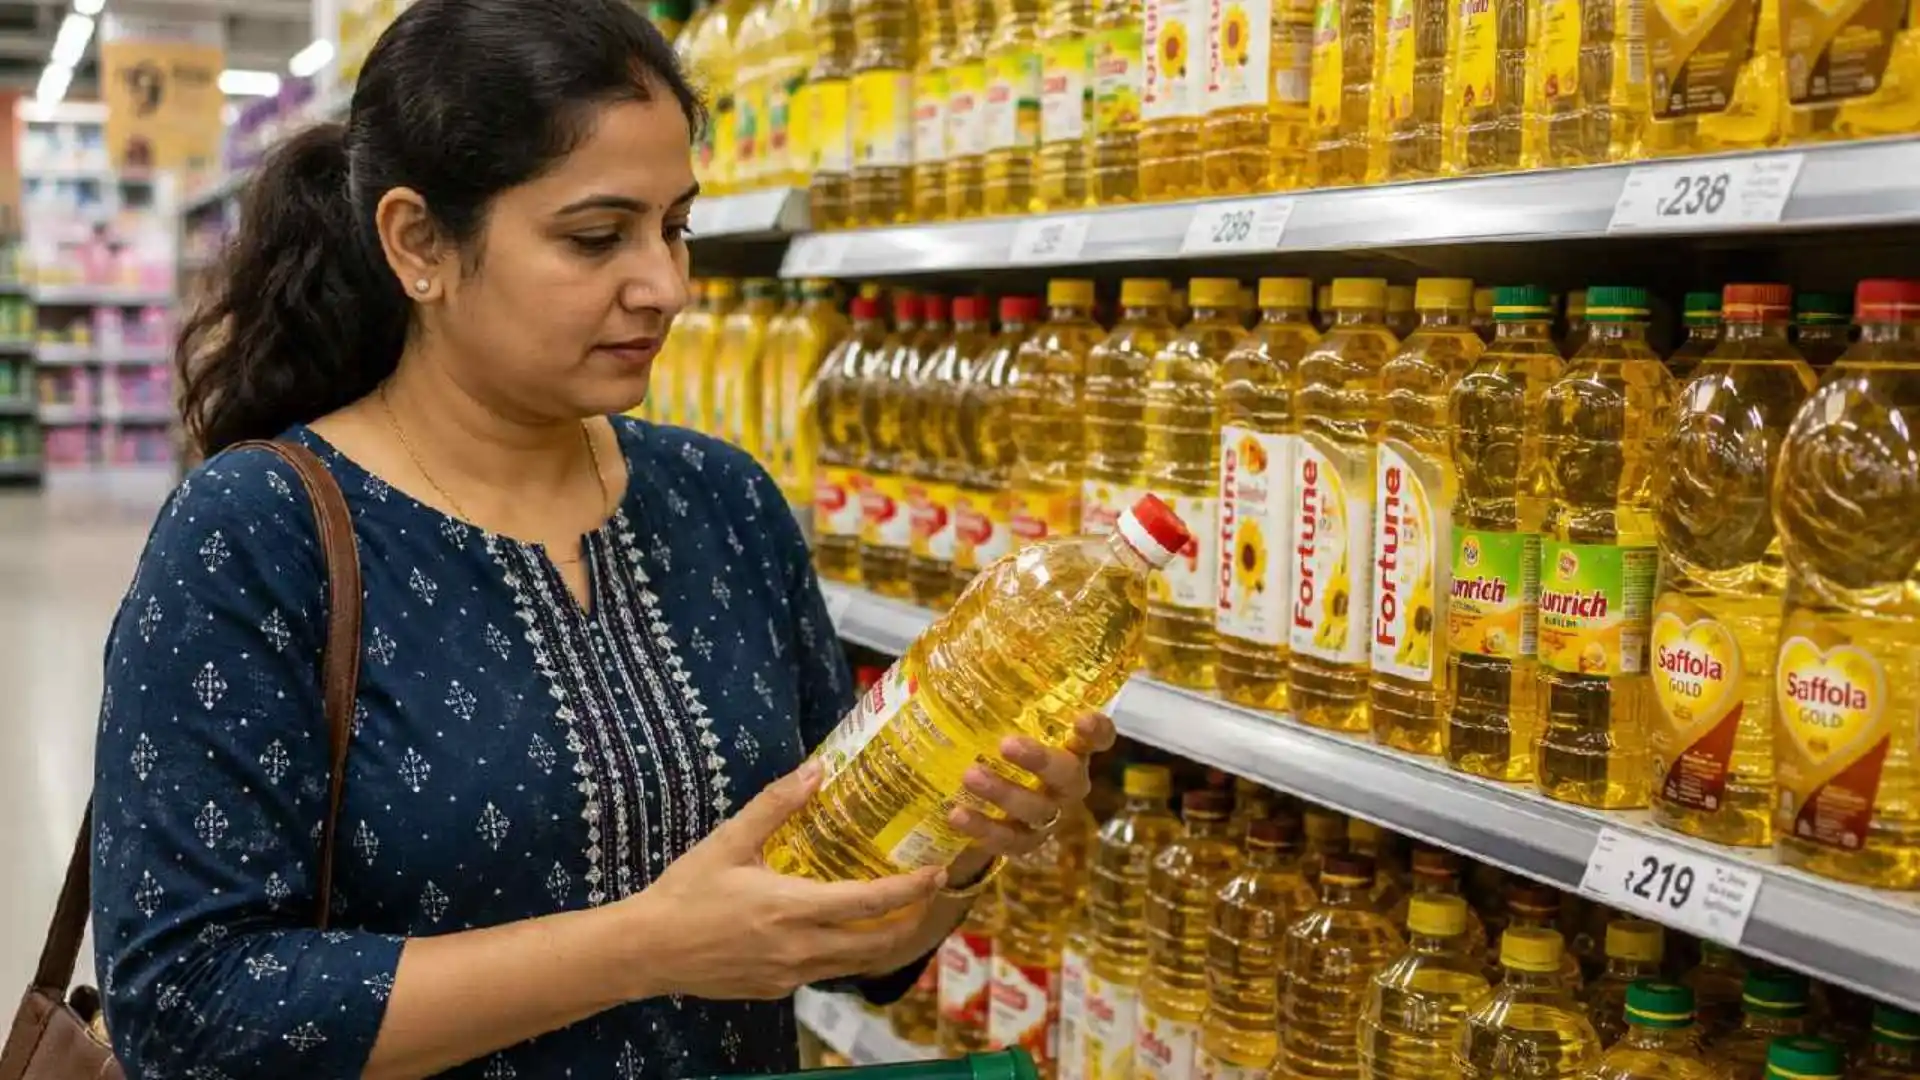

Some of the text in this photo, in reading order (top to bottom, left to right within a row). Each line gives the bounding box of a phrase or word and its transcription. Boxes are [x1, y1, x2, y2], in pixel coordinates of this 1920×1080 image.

[1219, 448, 1237, 611] Fortune
[1294, 458, 1318, 629] Fortune
[1376, 466, 1400, 647] Fortune
[1450, 575, 1507, 603] unrich
[1657, 645, 1724, 681] Saffola
[1667, 677, 1703, 699] GOLD
[1786, 671, 1867, 710] Saffola
[1798, 706, 1844, 729] GOLD
